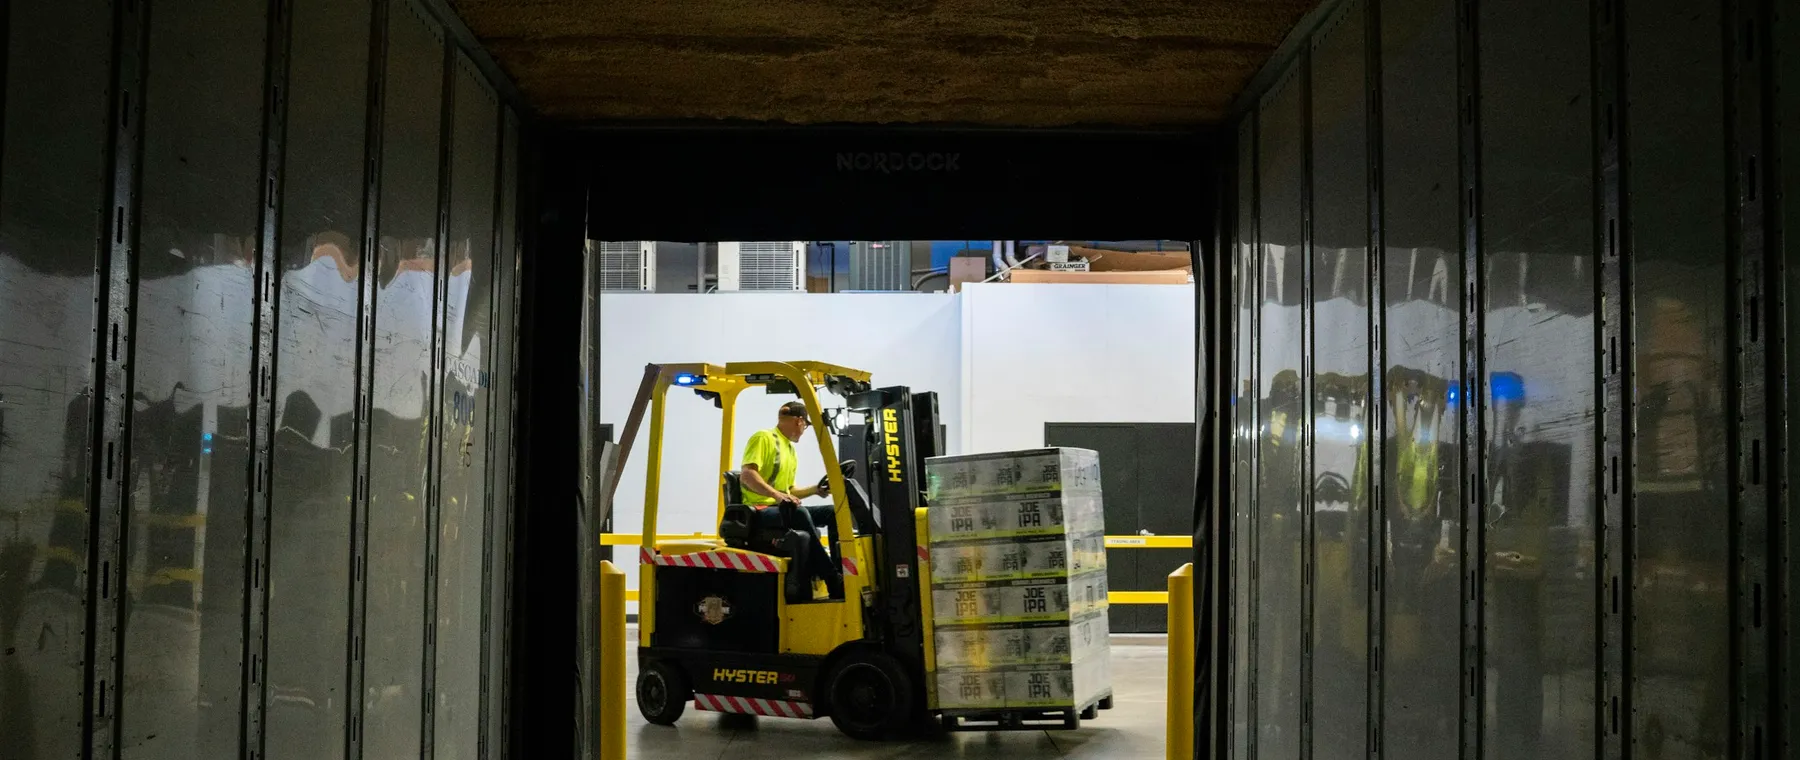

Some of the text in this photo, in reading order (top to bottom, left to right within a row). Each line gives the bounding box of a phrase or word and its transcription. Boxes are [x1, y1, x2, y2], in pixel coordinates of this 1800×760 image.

[835, 151, 961, 174] NORDOCK
[883, 408, 902, 483] HYSTER
[1043, 464, 1058, 473] JOE
[1043, 473, 1059, 482] IPA
[951, 506, 973, 518] JOE
[1018, 501, 1040, 513] JOE
[951, 518, 973, 532] IPA
[1018, 513, 1041, 528] IPA
[1003, 553, 1018, 561] JOE
[1049, 551, 1063, 559] JOE
[1003, 561, 1019, 571] IPA
[1048, 559, 1065, 569] IPA
[955, 591, 977, 602] JOE
[1023, 587, 1045, 599] JOE
[955, 602, 978, 616] IPA
[1023, 599, 1047, 613] IPA
[712, 667, 779, 684] HYSTER
[959, 675, 981, 686] JOE
[1028, 673, 1050, 684] JOE
[959, 686, 981, 699] IPA
[1027, 684, 1051, 698] IPA
